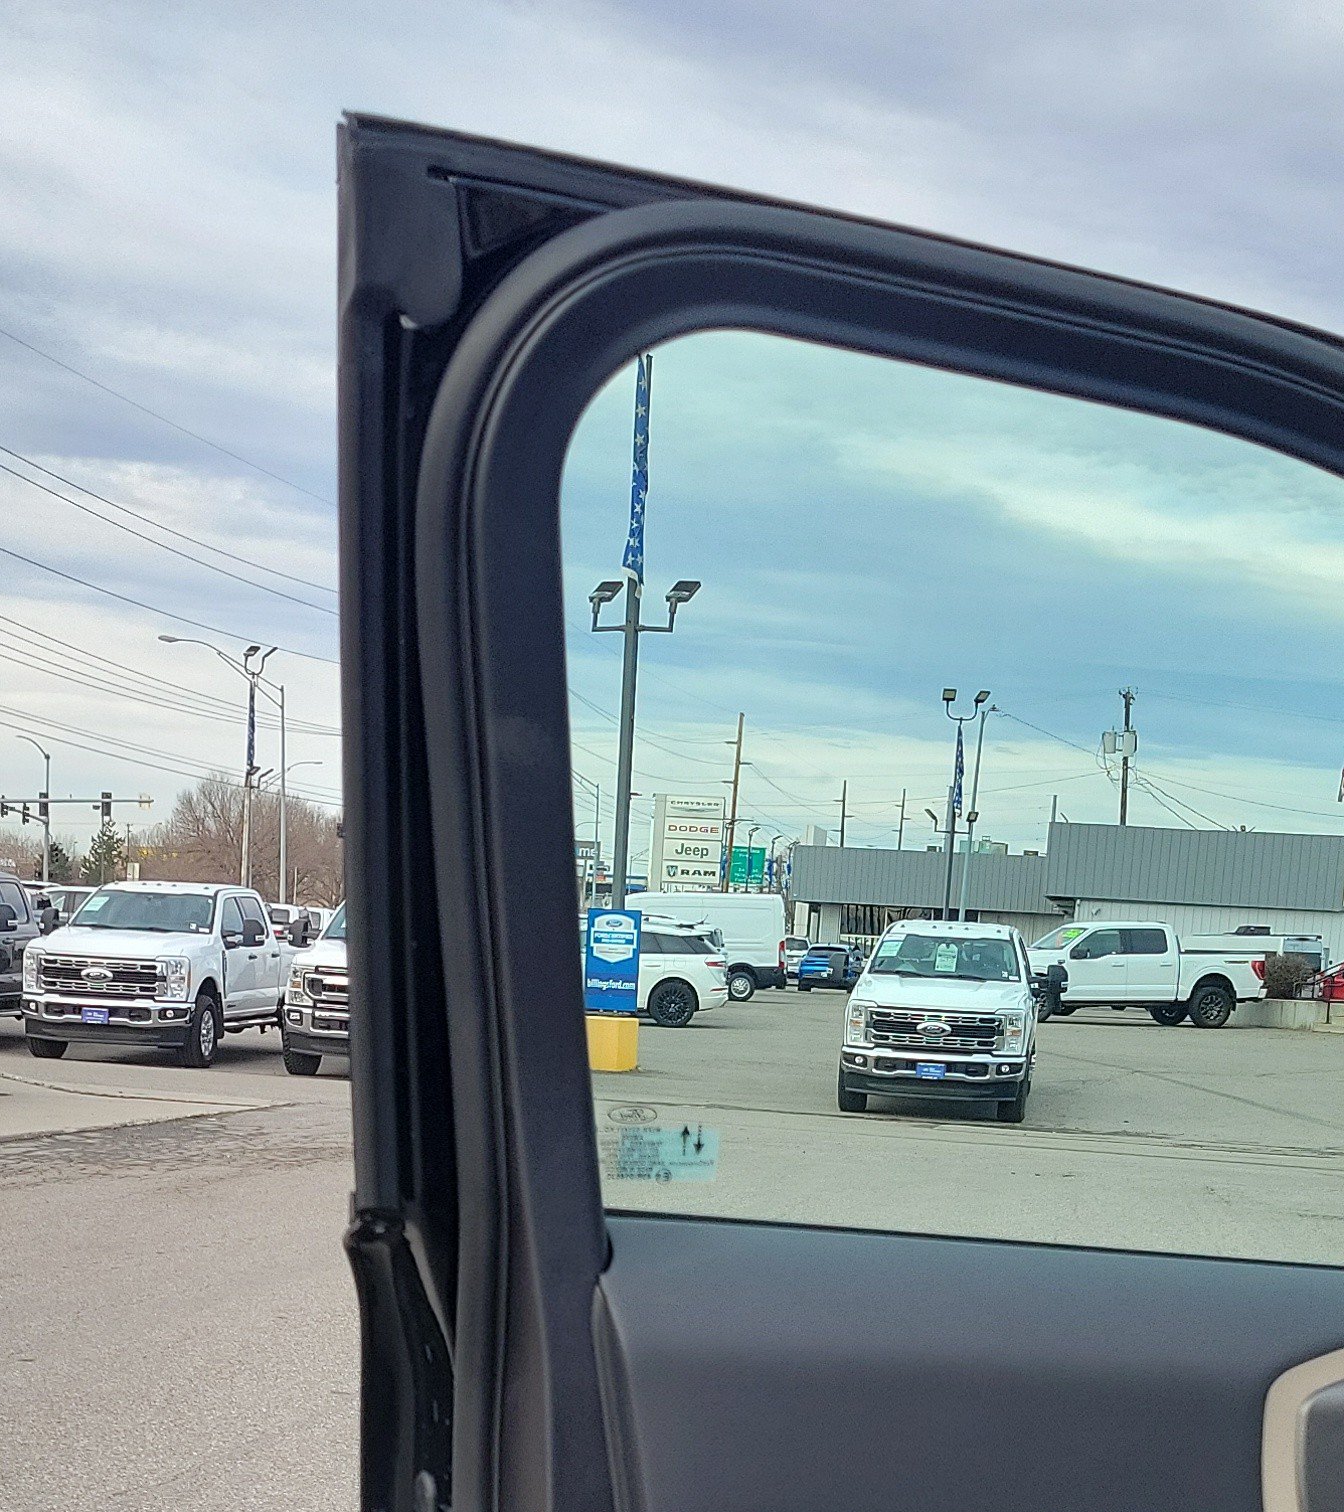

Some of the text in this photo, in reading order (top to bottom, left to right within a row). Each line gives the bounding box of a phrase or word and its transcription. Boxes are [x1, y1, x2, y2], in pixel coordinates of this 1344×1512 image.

[667, 824, 720, 834] DODGE
[674, 842, 709, 859] Jeep
[680, 868, 717, 877] RAM
